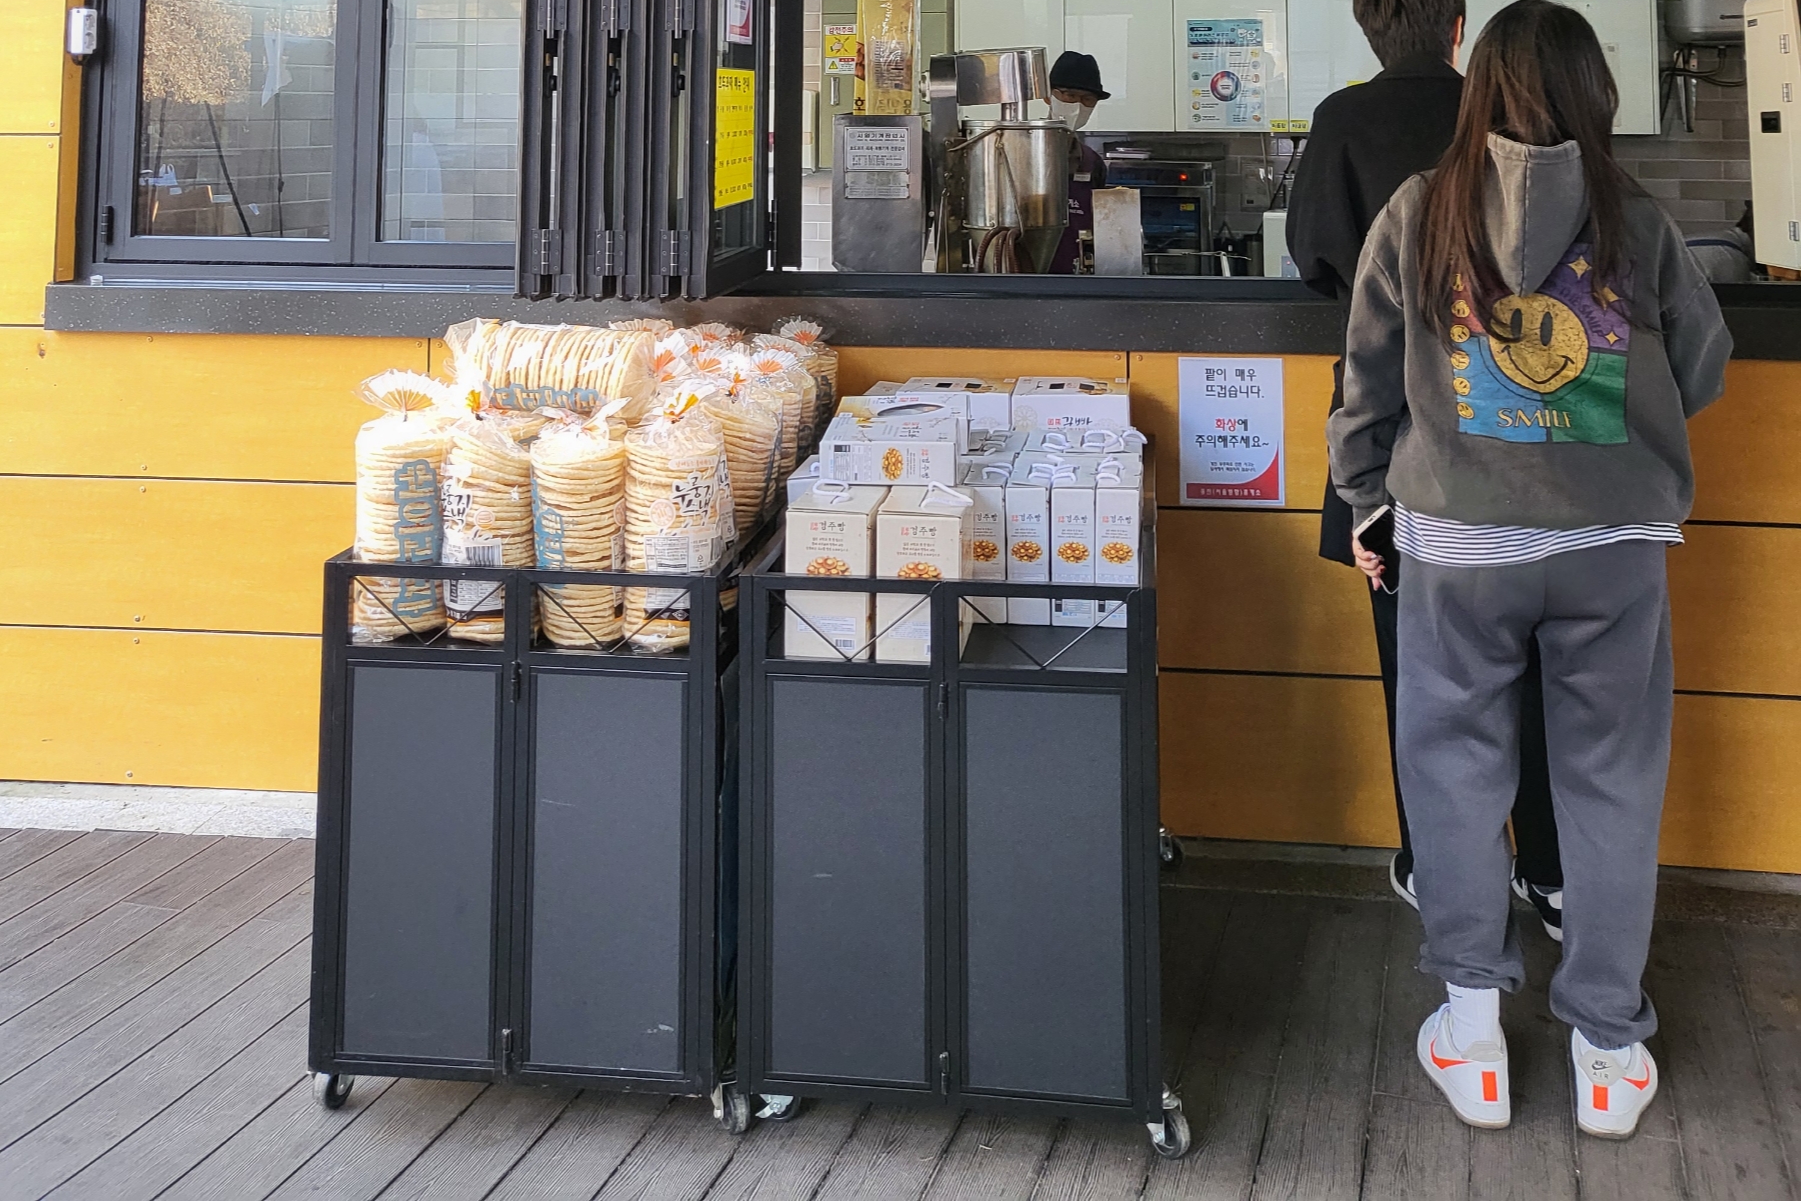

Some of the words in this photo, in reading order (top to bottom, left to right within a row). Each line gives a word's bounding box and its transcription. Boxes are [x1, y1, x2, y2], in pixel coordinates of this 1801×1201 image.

[1204, 368, 1227, 382] 팥이
[1234, 368, 1257, 382] 매우
[1205, 385, 1265, 399] 뜨겁습니다.
[1215, 418, 1249, 432] 화상에
[1195, 434, 1270, 449] 주의해주세요~
[672, 476, 714, 505] 누룽지
[1018, 512, 1042, 523] 경주빵
[1065, 513, 1088, 524] 경주빵
[1109, 513, 1133, 524] 경주빵
[819, 520, 846, 532] 경주빵
[910, 525, 937, 537] 경주빵
[1592, 1071, 1609, 1079] AIR
